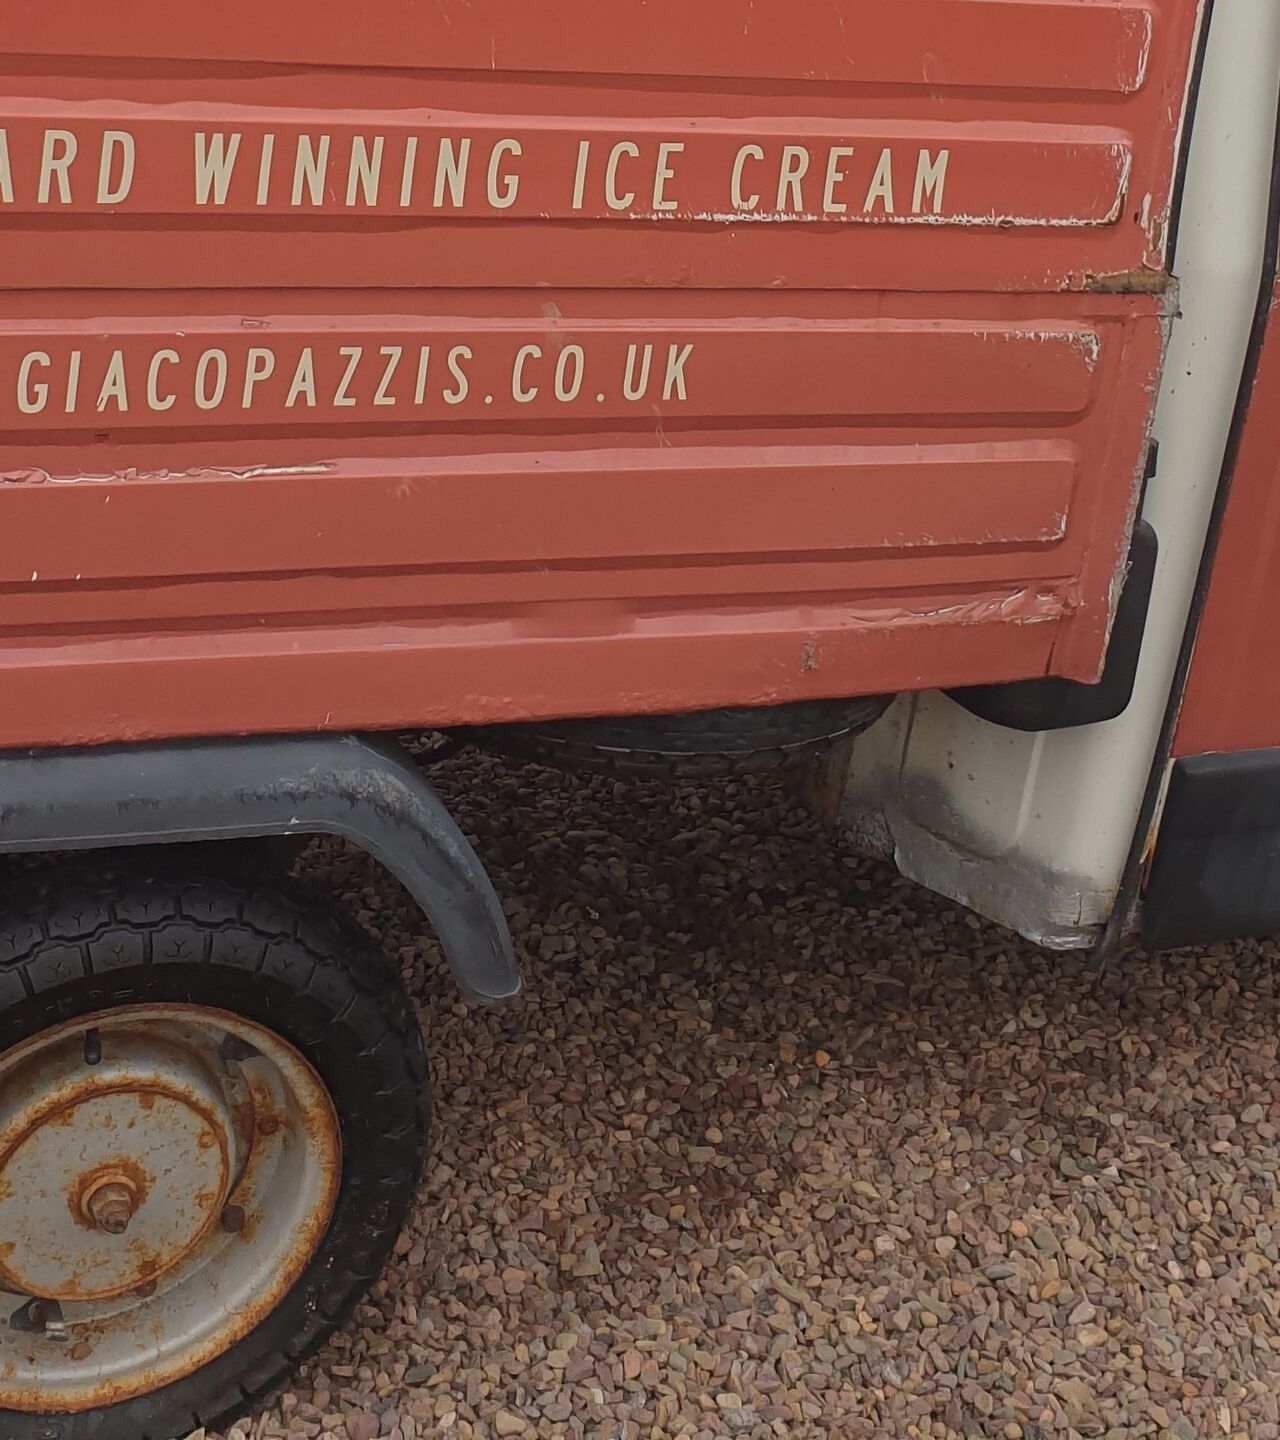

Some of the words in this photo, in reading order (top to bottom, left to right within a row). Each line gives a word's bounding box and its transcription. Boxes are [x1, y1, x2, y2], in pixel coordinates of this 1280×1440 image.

[194, 132, 523, 209] WINNING
[571, 140, 685, 210] ICE
[730, 144, 950, 213] CREAM
